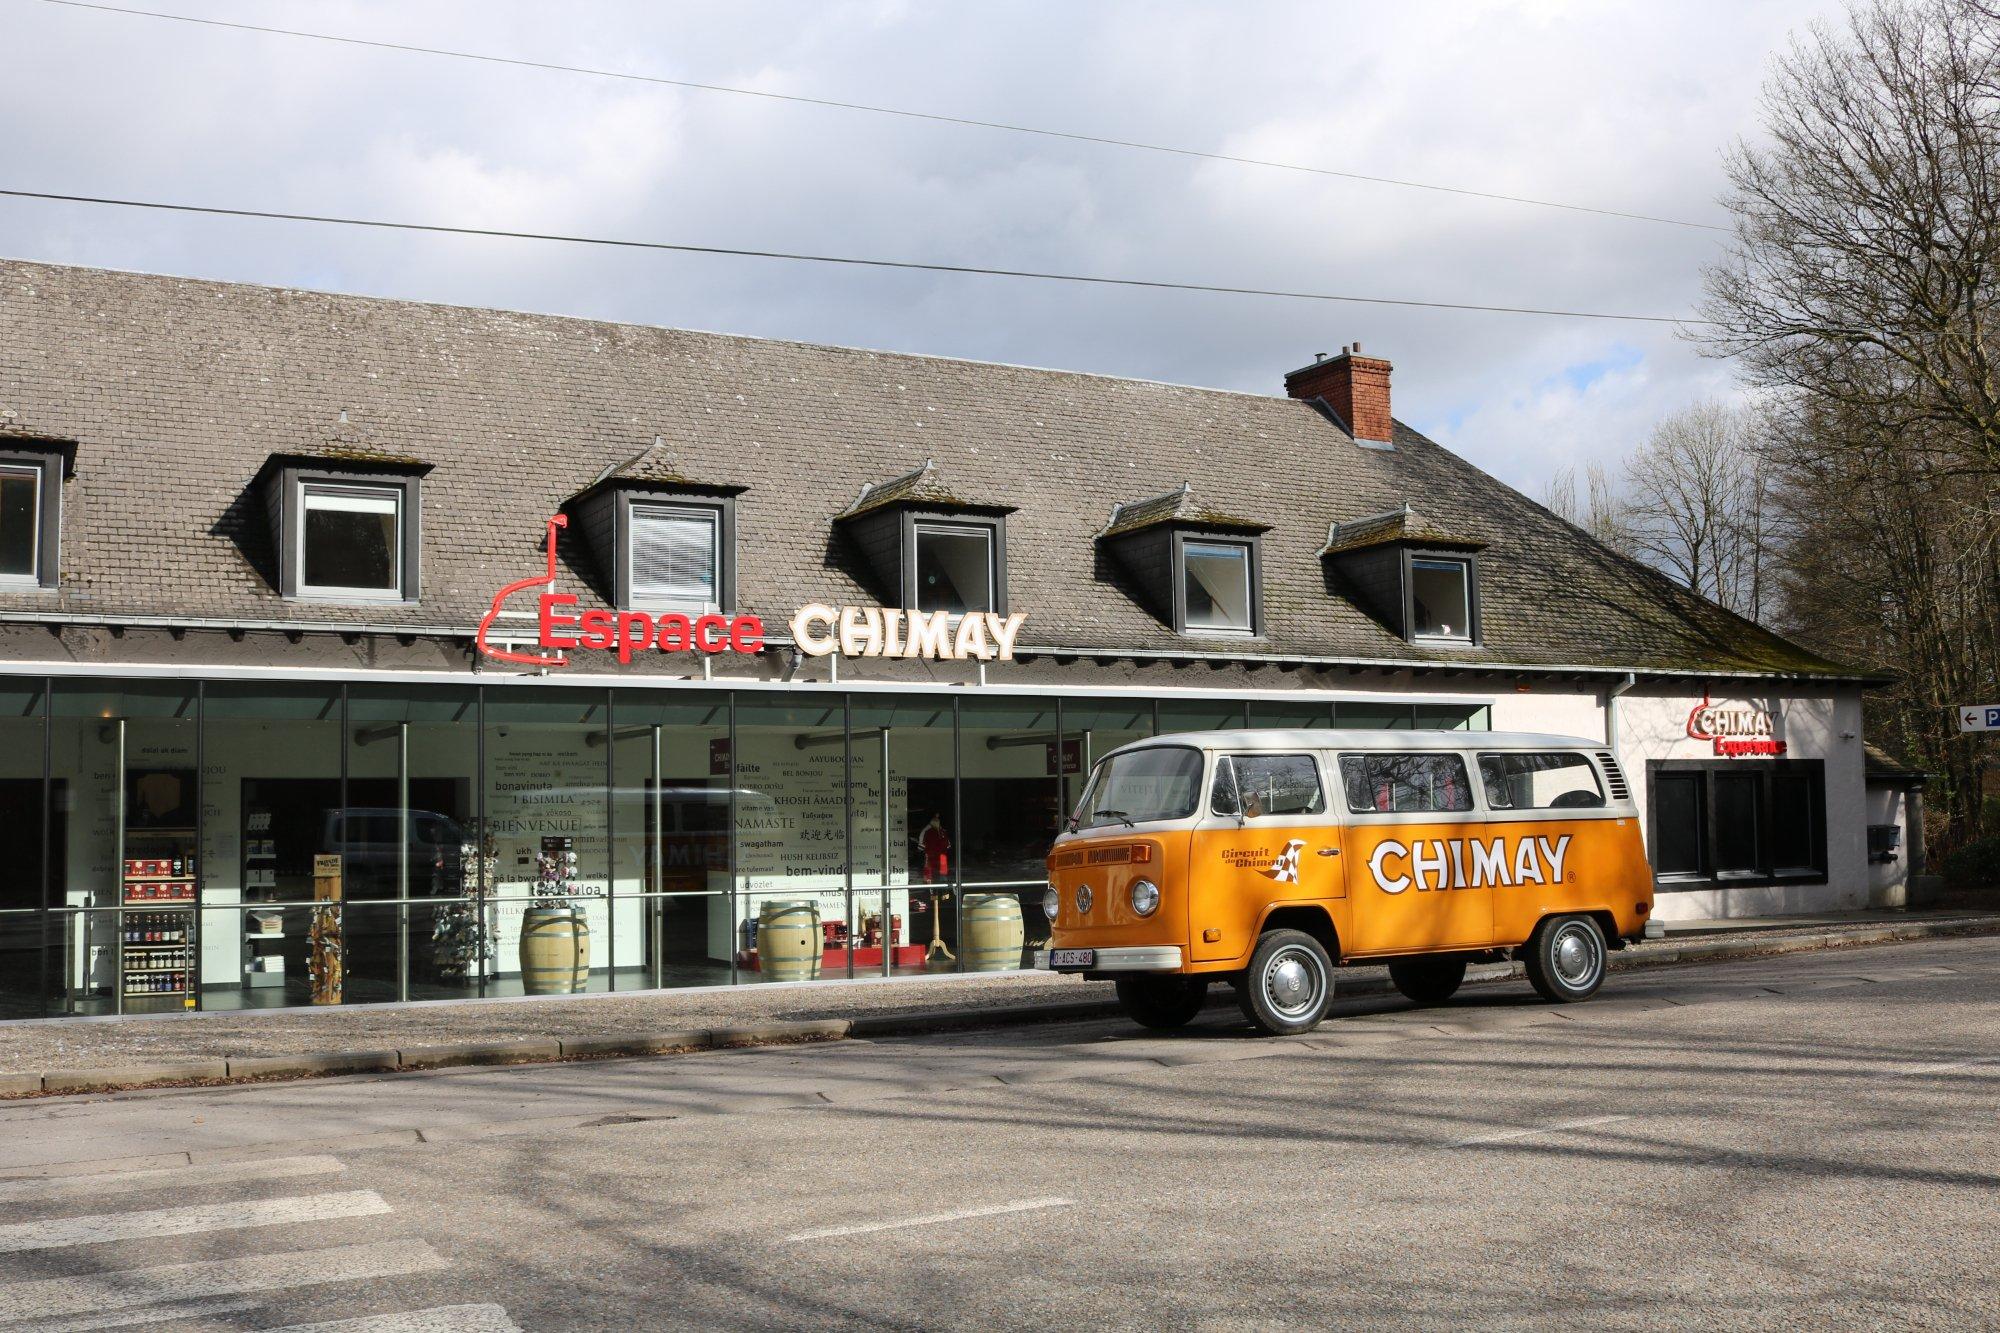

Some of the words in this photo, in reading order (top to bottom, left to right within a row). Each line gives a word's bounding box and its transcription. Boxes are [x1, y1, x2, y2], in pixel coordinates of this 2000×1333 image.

[539, 594, 764, 664] Espace
[788, 603, 1028, 661] CHIMAY
[1698, 710, 1779, 735] CHIMAY
[1989, 711, 1998, 724] P
[495, 781, 553, 791] bonavinuta
[522, 795, 574, 803] BISIMILA
[774, 796, 810, 805] KHOSH
[493, 820, 578, 832] BIENVENUE
[736, 818, 796, 828] NAMASTE
[739, 840, 784, 849] swagatham
[780, 853, 803, 861] HUSH
[1222, 847, 1269, 858] Circuit
[1235, 857, 1283, 868] Chimay
[1366, 834, 1574, 895] CHIMAY
